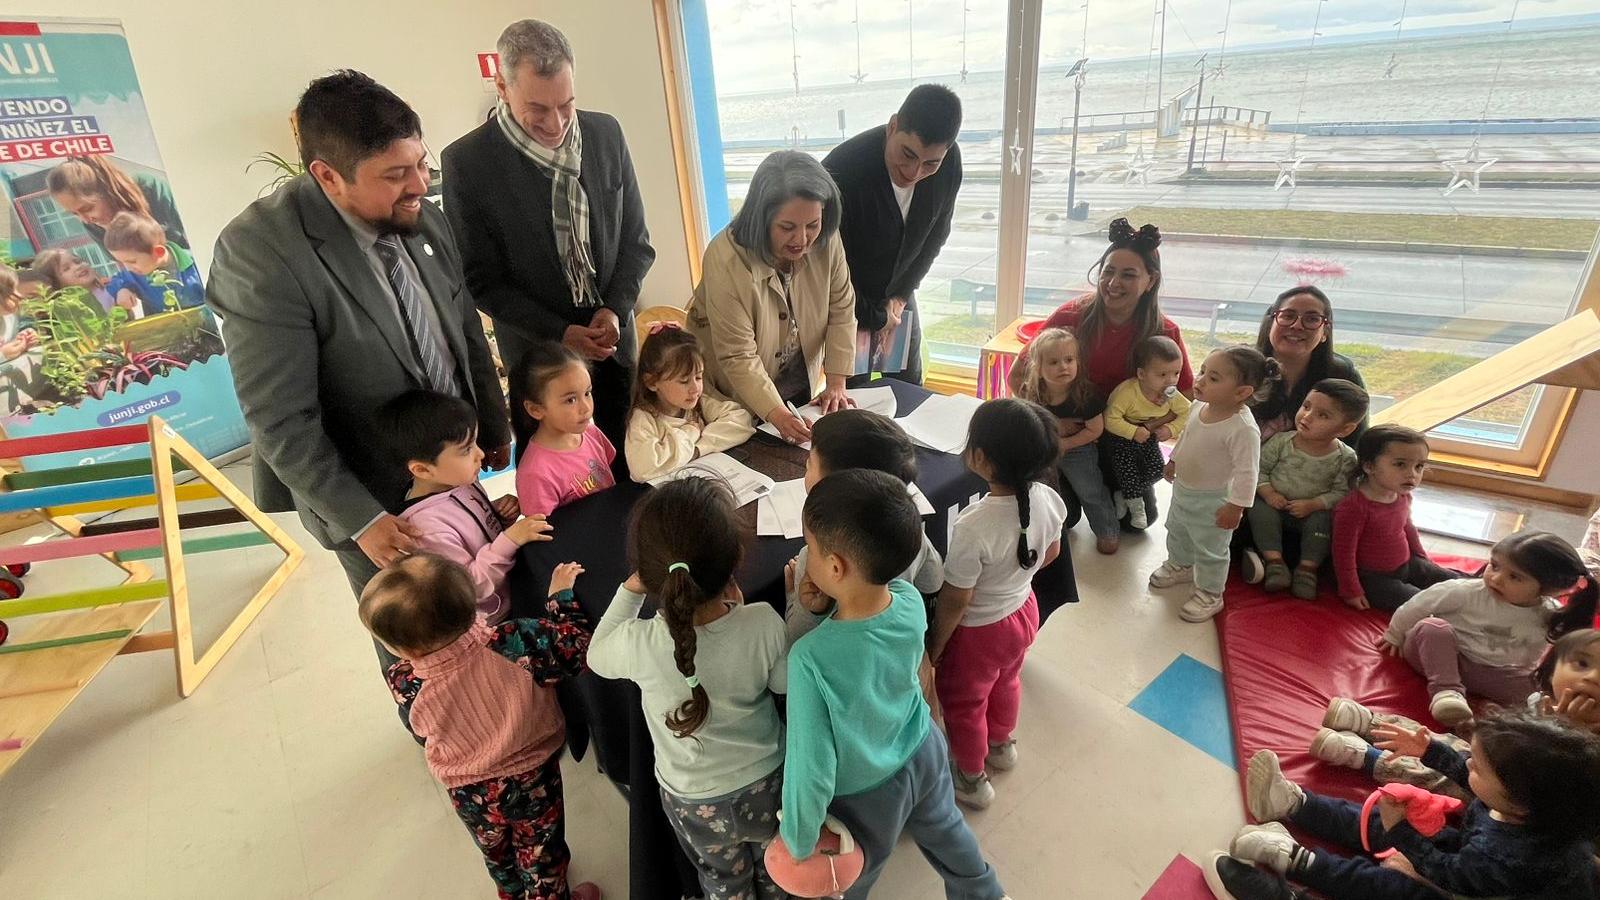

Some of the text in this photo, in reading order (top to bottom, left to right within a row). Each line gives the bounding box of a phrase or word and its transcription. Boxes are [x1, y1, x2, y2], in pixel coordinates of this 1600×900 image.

[0, 119, 97, 139] NIÑEZ EL
[15, 143, 47, 159] DE
[50, 137, 111, 155] CHILE
[109, 395, 170, 423] junji.gob.cl
